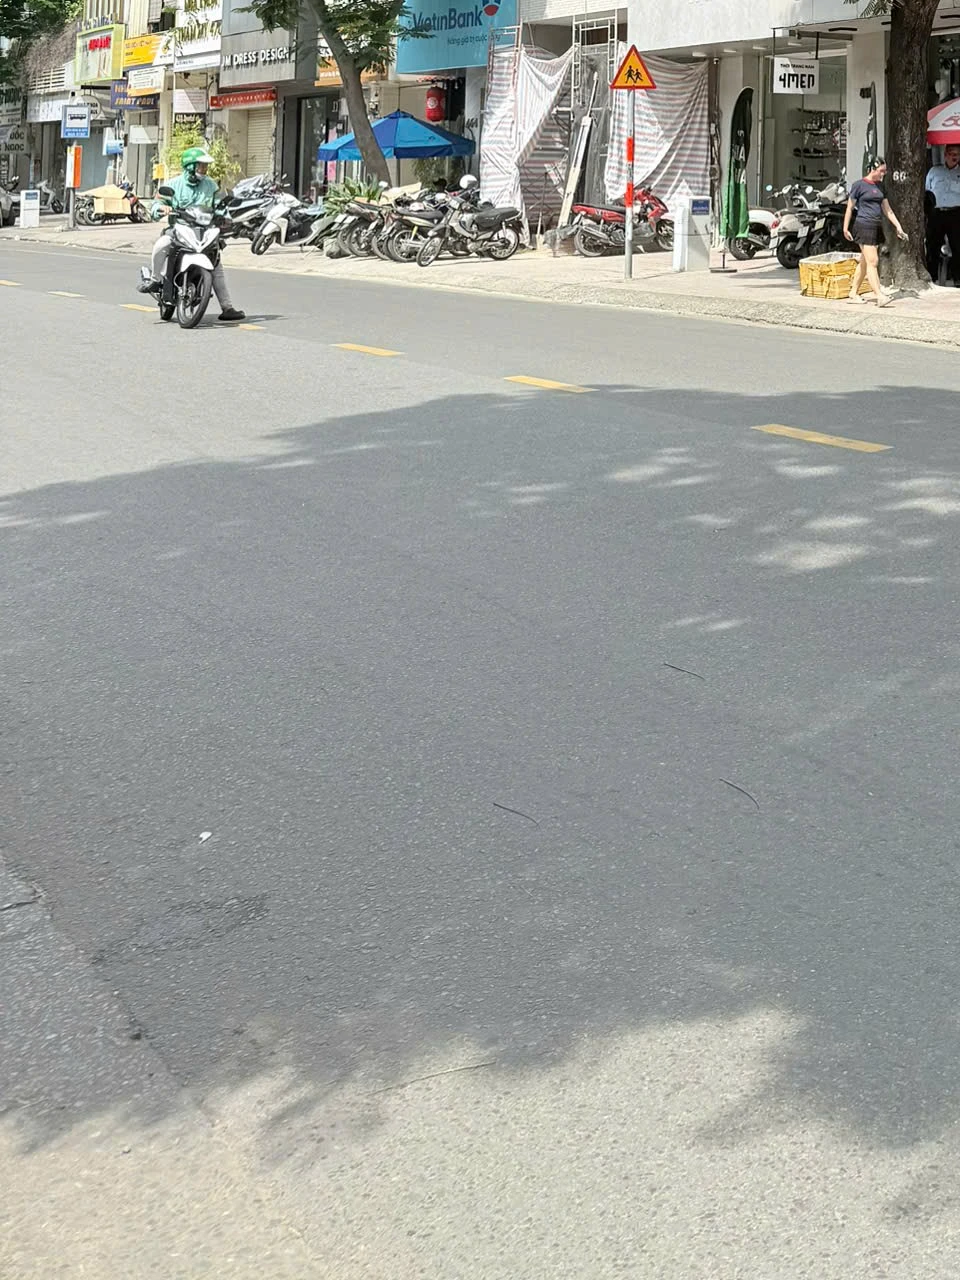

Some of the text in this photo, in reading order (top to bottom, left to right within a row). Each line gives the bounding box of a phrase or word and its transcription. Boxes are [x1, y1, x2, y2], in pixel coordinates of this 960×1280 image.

[412, 5, 483, 33] VietinBank
[233, 51, 257, 67] DRESS
[261, 46, 290, 63] DESIGN
[778, 73, 815, 89] 4MEN
